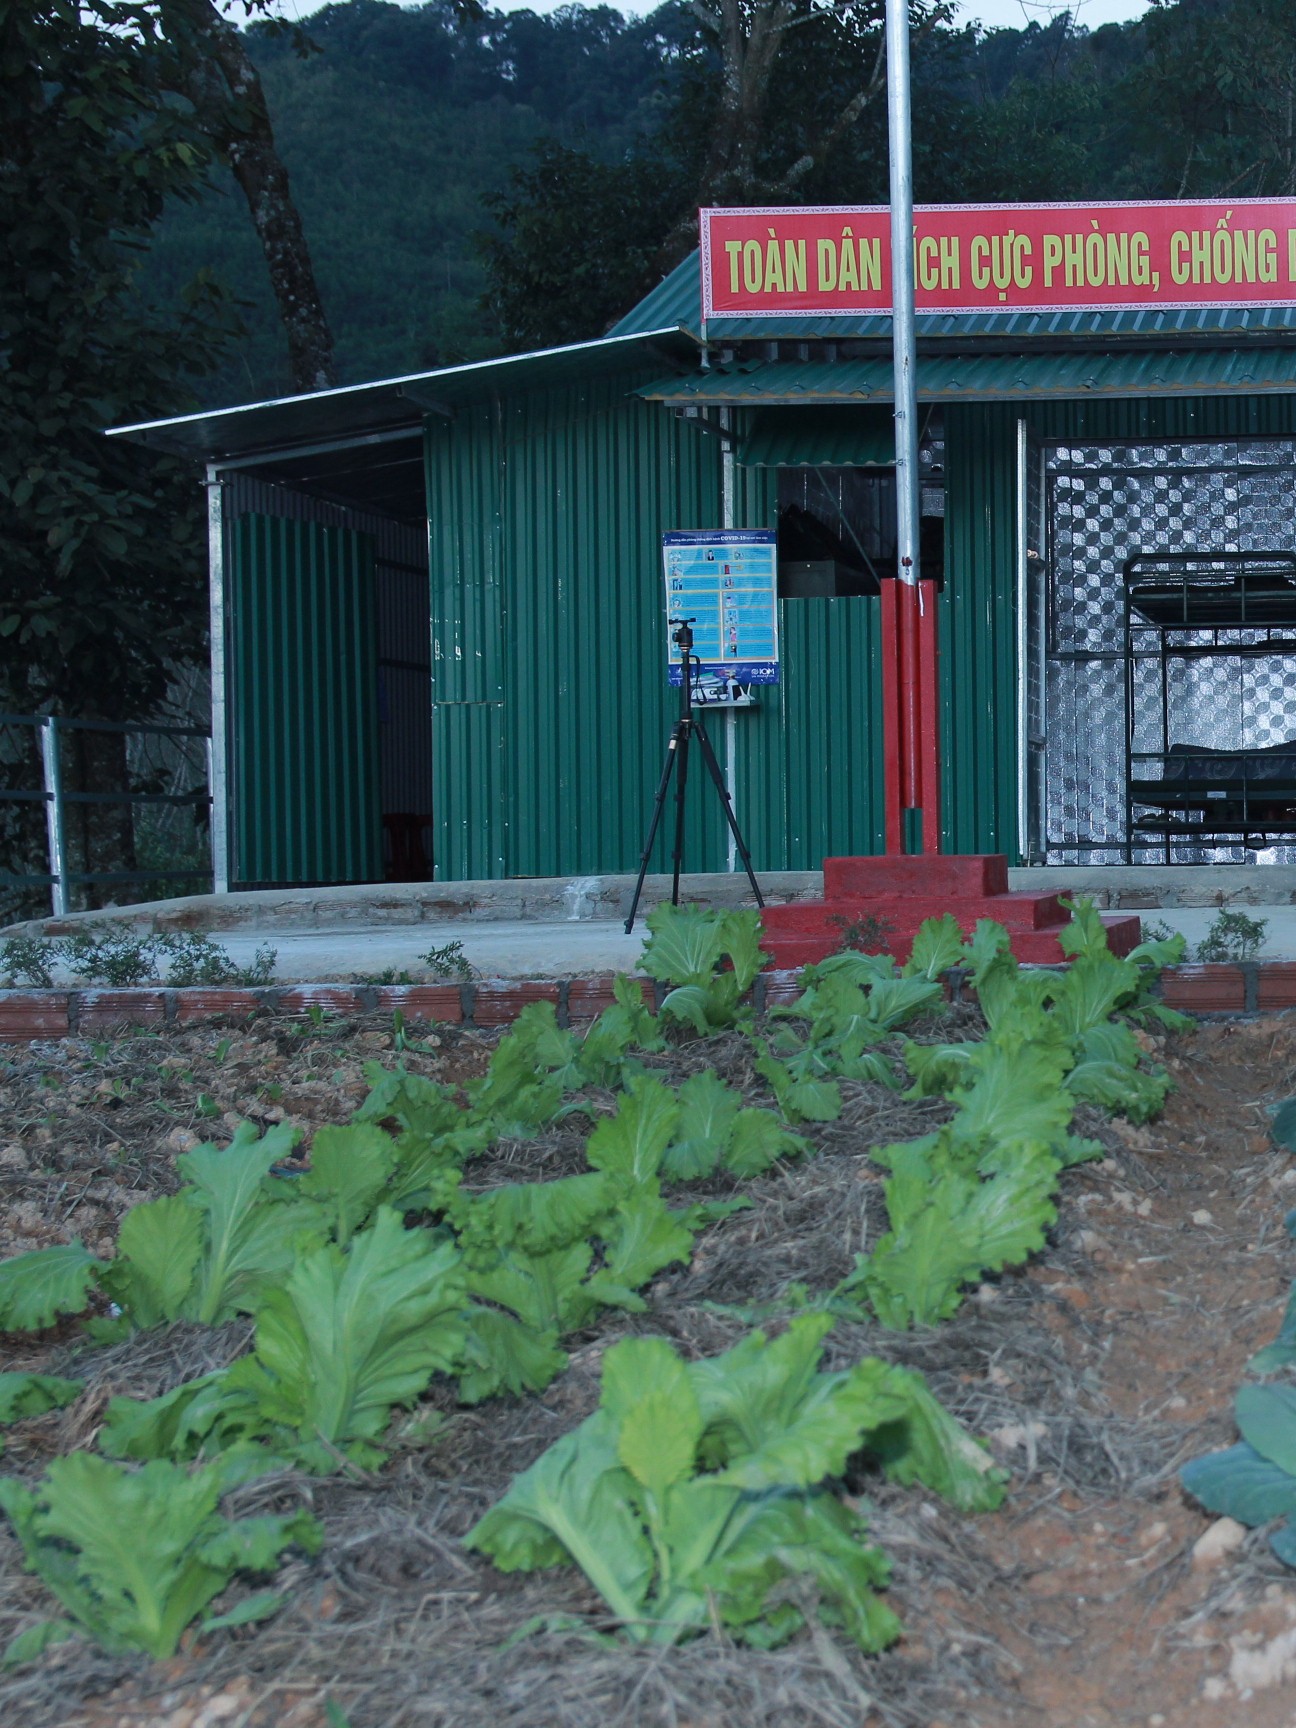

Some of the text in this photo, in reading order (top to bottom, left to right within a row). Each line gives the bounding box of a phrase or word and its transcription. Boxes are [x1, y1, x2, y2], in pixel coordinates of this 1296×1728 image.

[725, 228, 807, 293] TOÀN
[817, 227, 882, 293] DÂN
[912, 225, 961, 291] CH
[971, 229, 1033, 301] CỰC
[1043, 219, 1160, 293] PHÒNG,
[1170, 210, 1278, 284] CHỐNG
